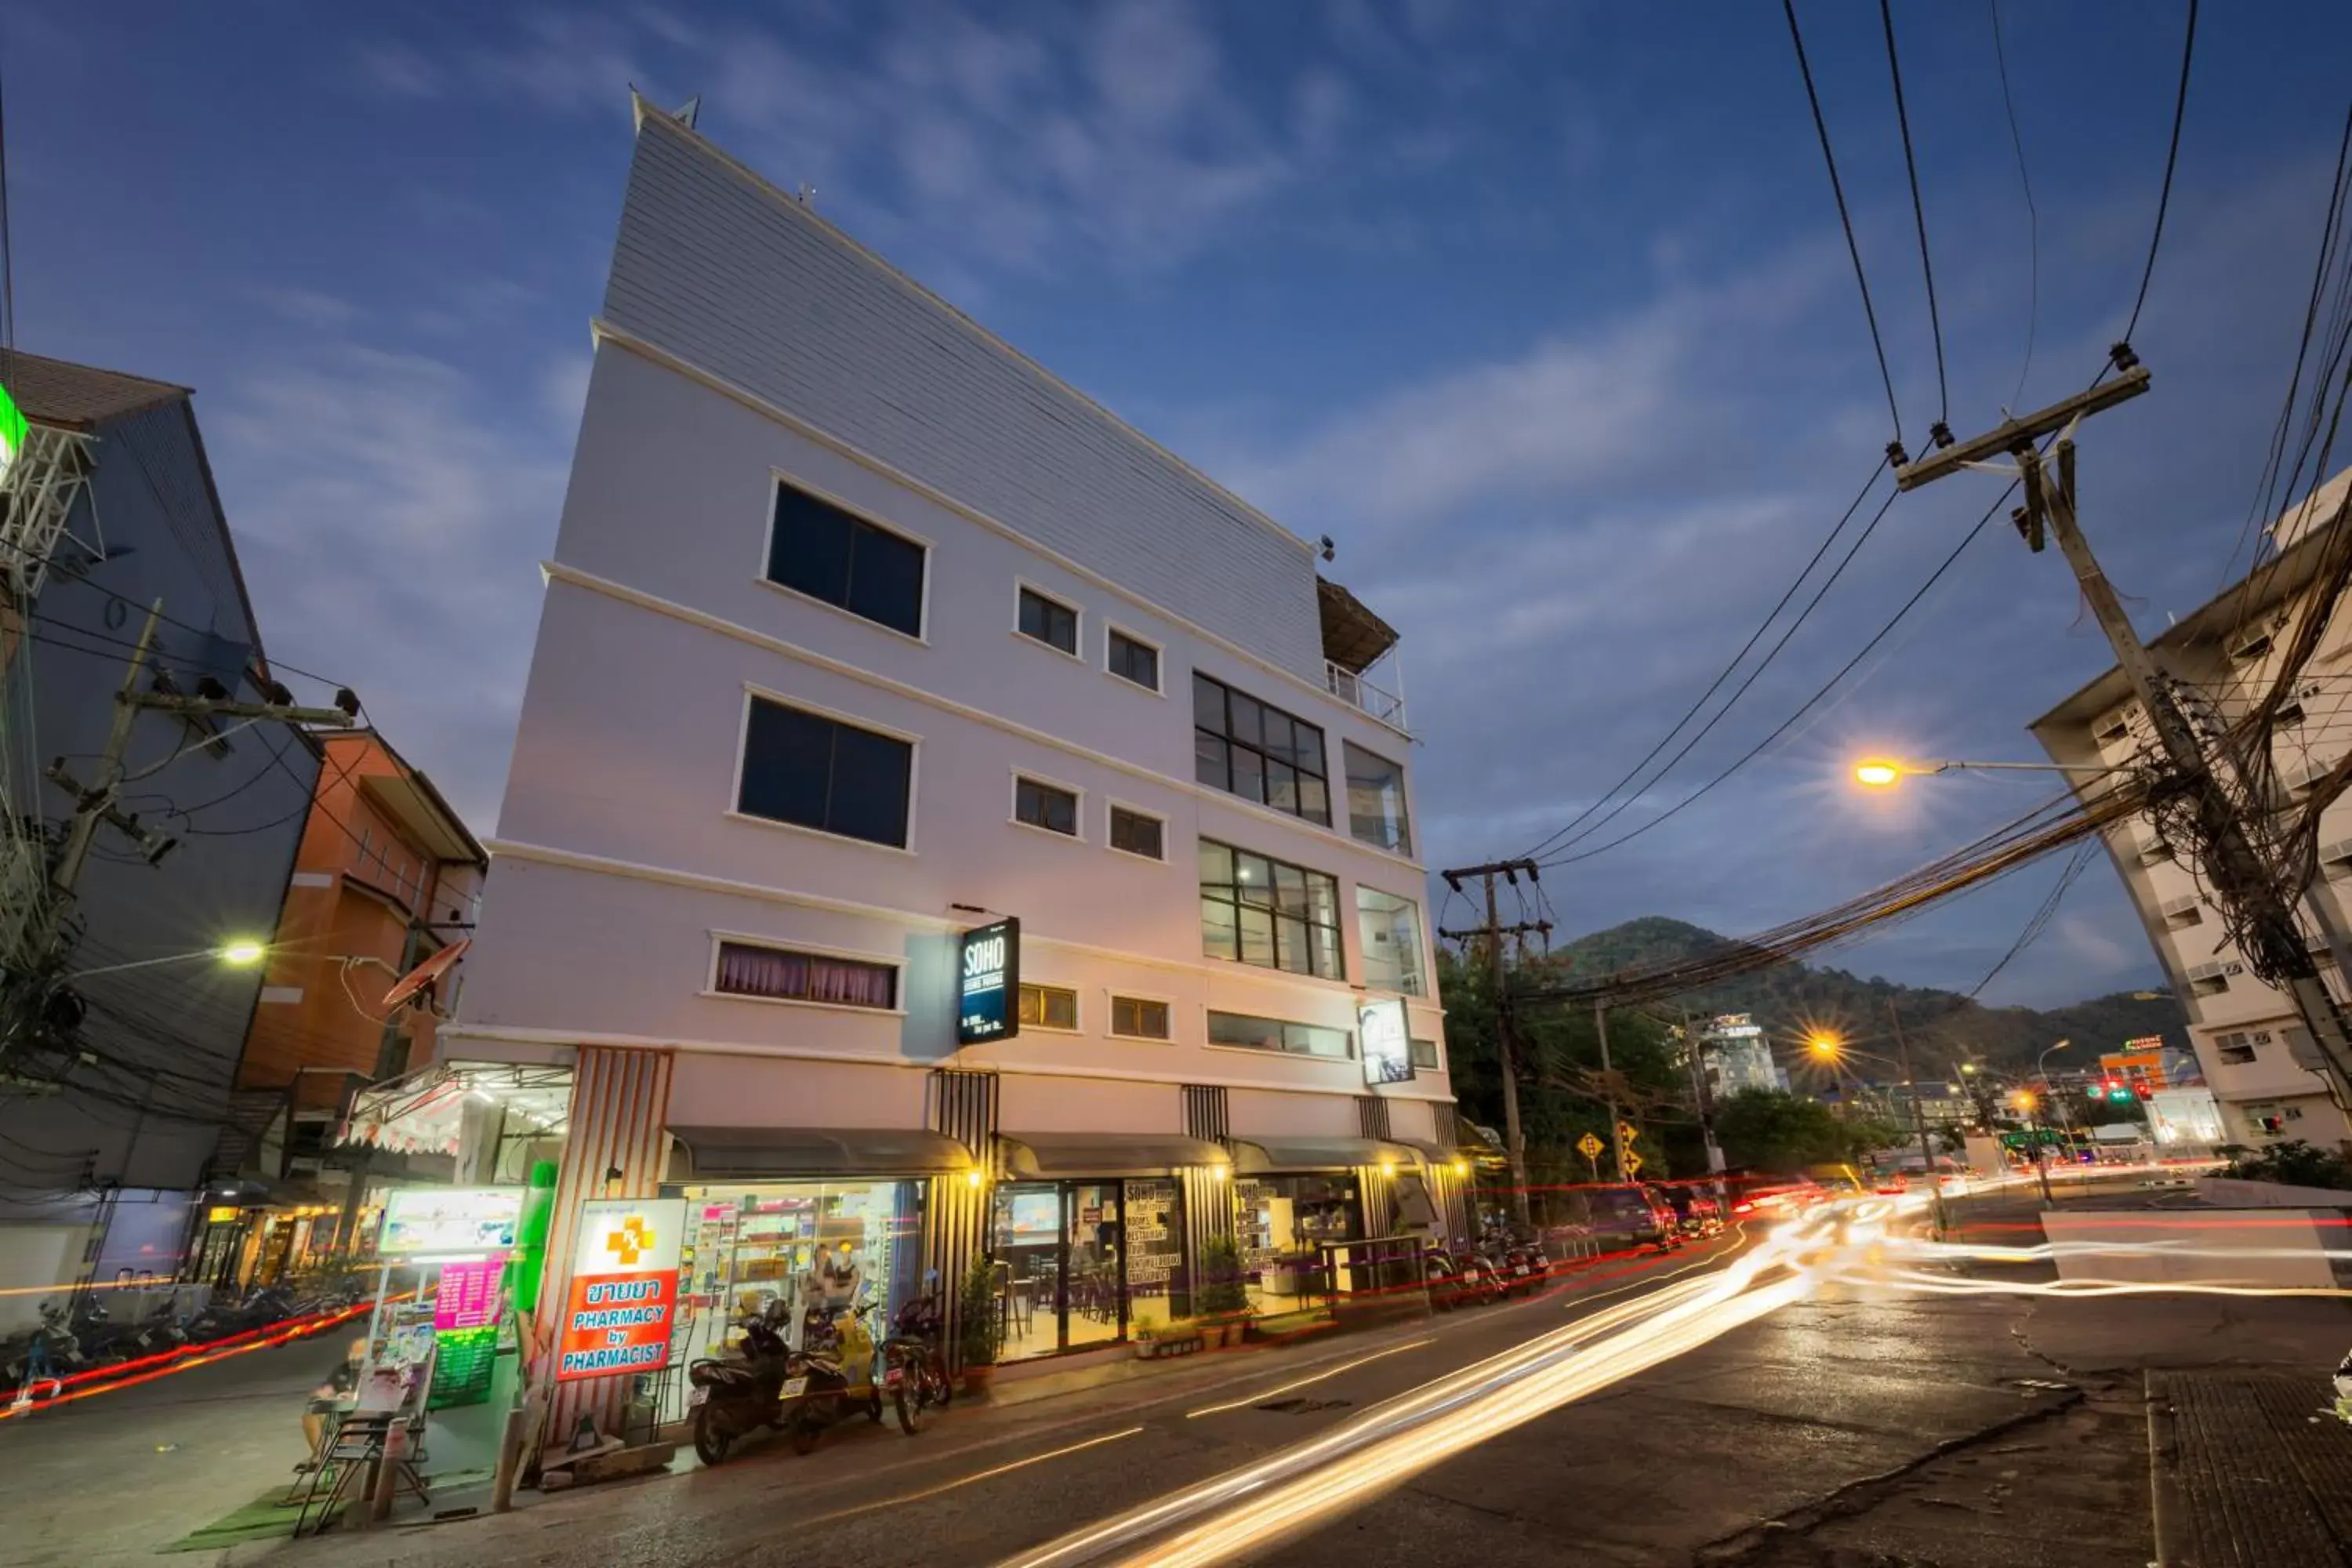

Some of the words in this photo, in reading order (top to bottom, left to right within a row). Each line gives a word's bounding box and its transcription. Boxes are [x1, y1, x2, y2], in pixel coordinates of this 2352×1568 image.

[964, 937, 1004, 976] SOHO
[1127, 1185, 1155, 1201] SOHO
[588, 1279, 660, 1304] ขายยา
[573, 1305, 666, 1330] PHARMACY
[608, 1330, 627, 1345] by
[562, 1344, 665, 1374] PHARMACIST
